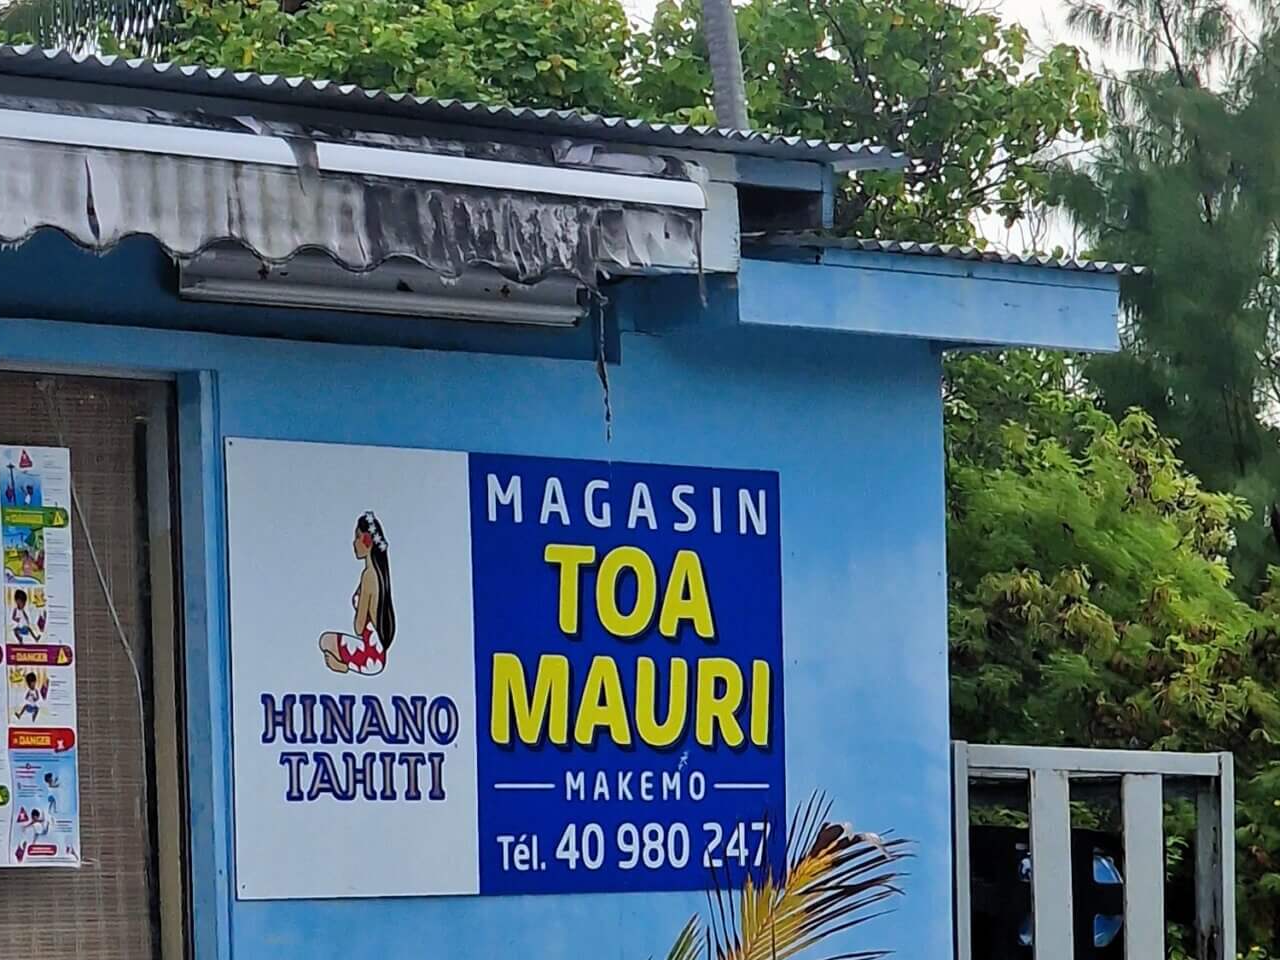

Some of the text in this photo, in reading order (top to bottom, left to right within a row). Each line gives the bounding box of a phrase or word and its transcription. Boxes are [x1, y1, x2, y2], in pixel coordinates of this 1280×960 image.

[486, 473, 768, 536] MAGASIN
[543, 543, 716, 640] TOA
[260, 693, 460, 746] HINANO
[489, 652, 772, 748] MAURI
[279, 751, 446, 802] TAHITI
[565, 771, 706, 801] MAKEMO
[496, 821, 771, 871] Tél. 40 980 247
